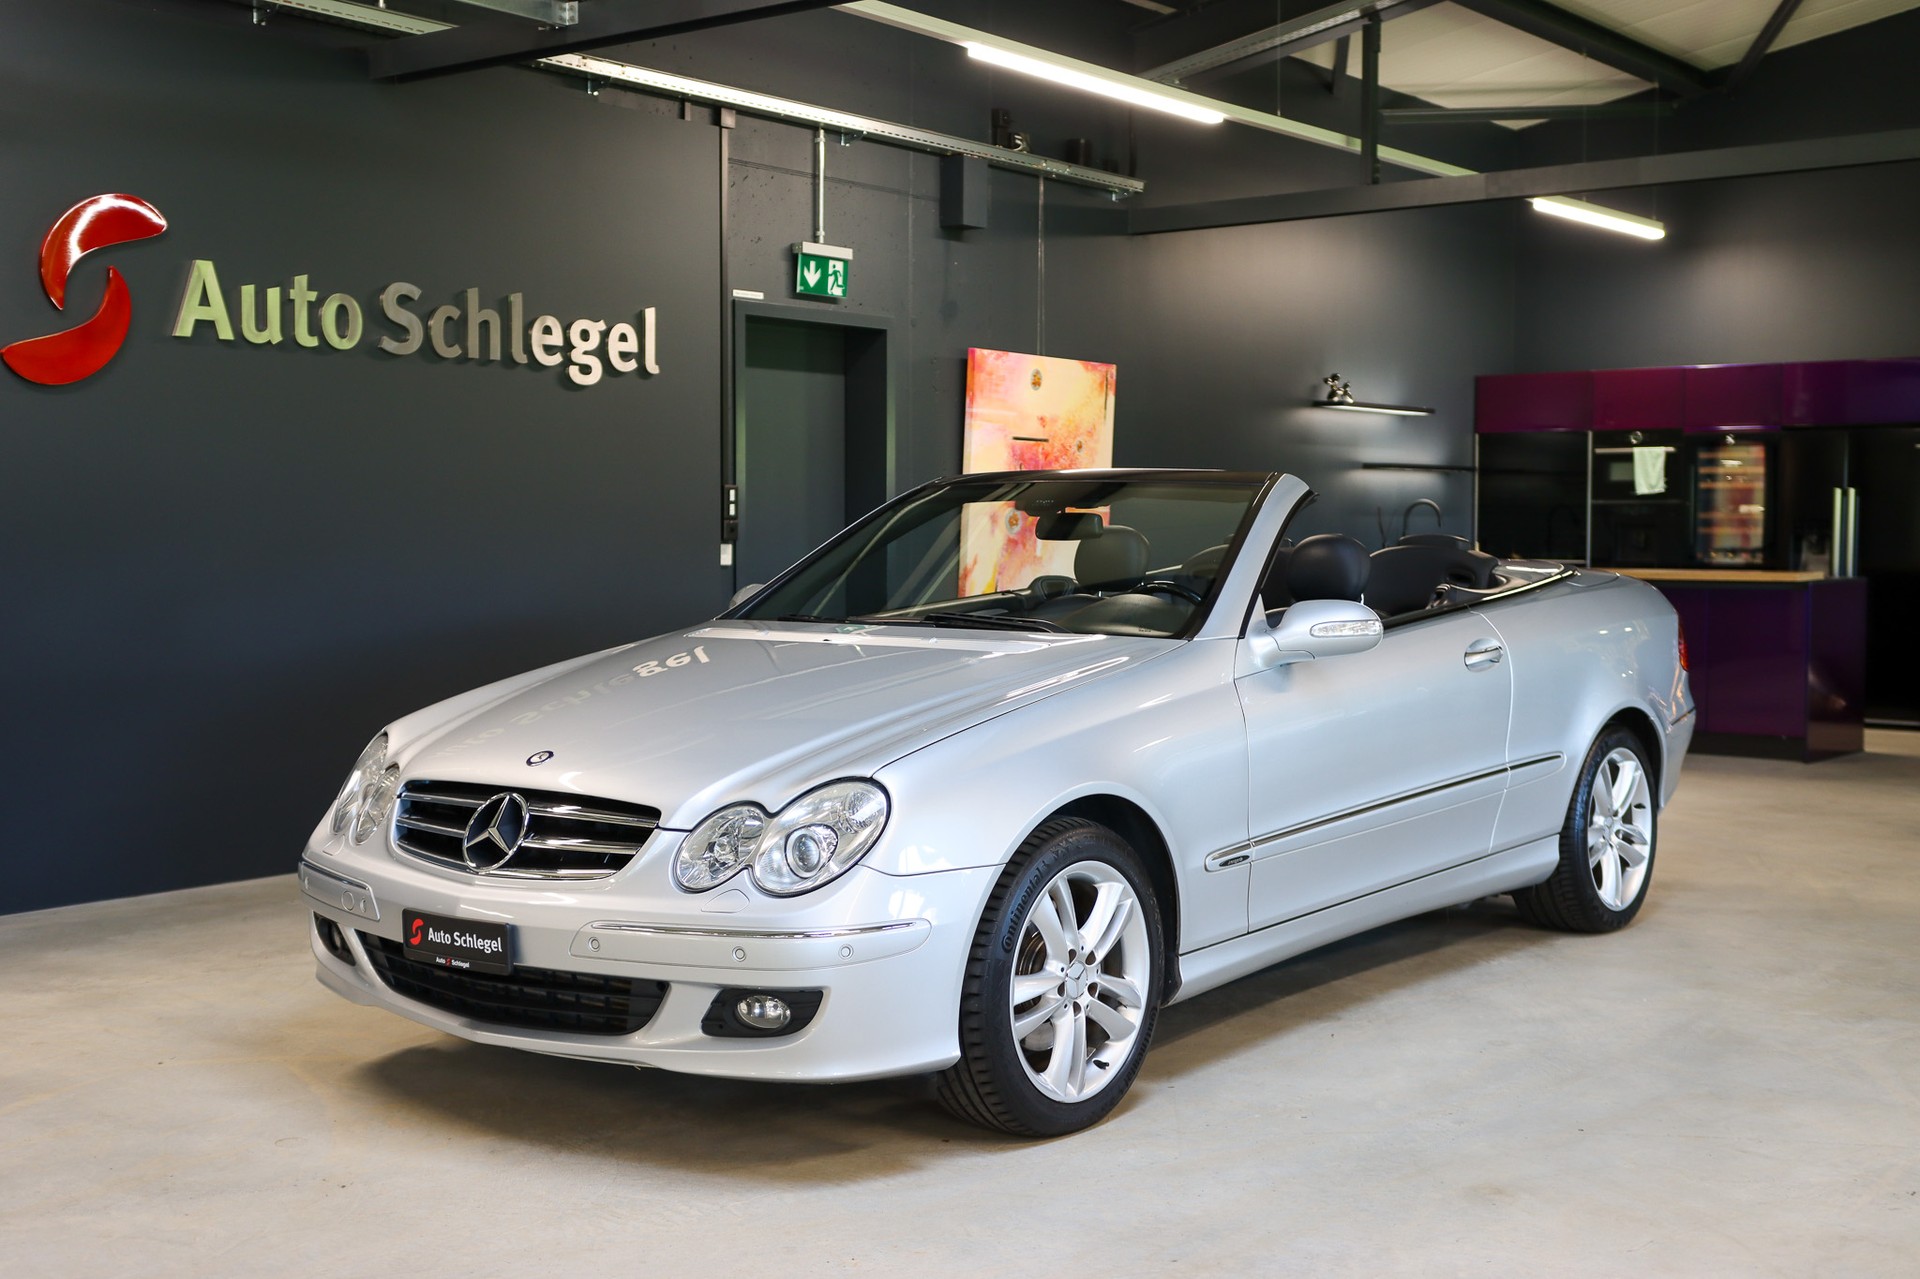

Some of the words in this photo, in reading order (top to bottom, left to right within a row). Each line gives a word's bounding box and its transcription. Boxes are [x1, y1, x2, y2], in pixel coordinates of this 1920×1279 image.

[171, 259, 363, 351] Auto
[377, 281, 660, 386] Schlegel
[1002, 867, 1044, 954] Continental
[428, 927, 451, 945] Auto
[453, 931, 503, 954] Schlegel
[452, 960, 470, 968] Schlegel
